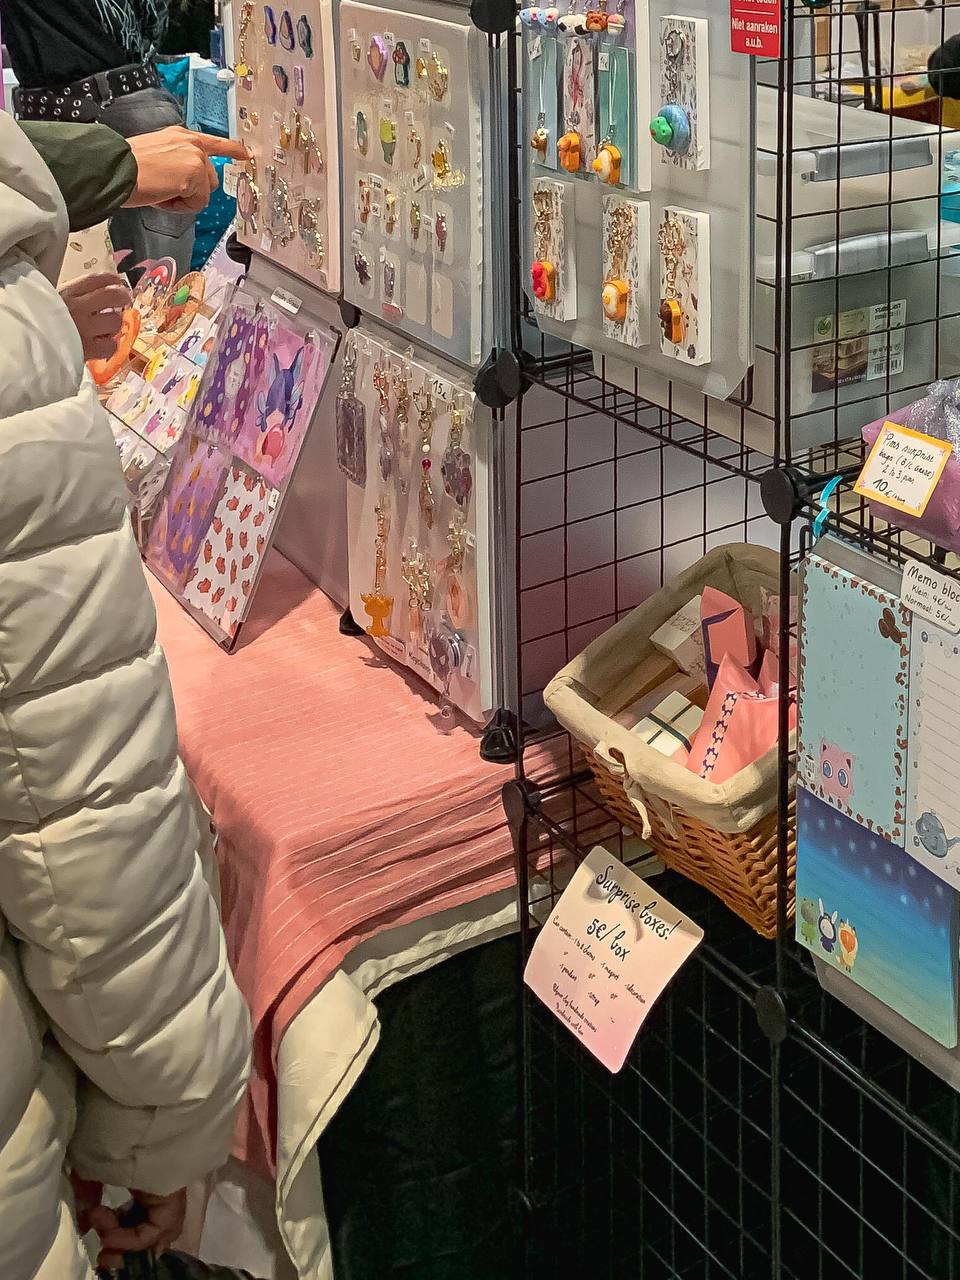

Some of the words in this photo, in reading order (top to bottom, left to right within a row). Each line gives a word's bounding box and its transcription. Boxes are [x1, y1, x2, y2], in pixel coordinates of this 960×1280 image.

[731, 17, 745, 31] Niet
[746, 20, 778, 34] aanraken
[745, 36, 764, 49] a.u.b.
[907, 565, 937, 590] Memo
[941, 582, 960, 602] bloc
[911, 584, 930, 599] Klein:
[904, 593, 932, 614] Normaal:
[595, 864, 641, 915] Surprise
[639, 901, 683, 940] boxes!
